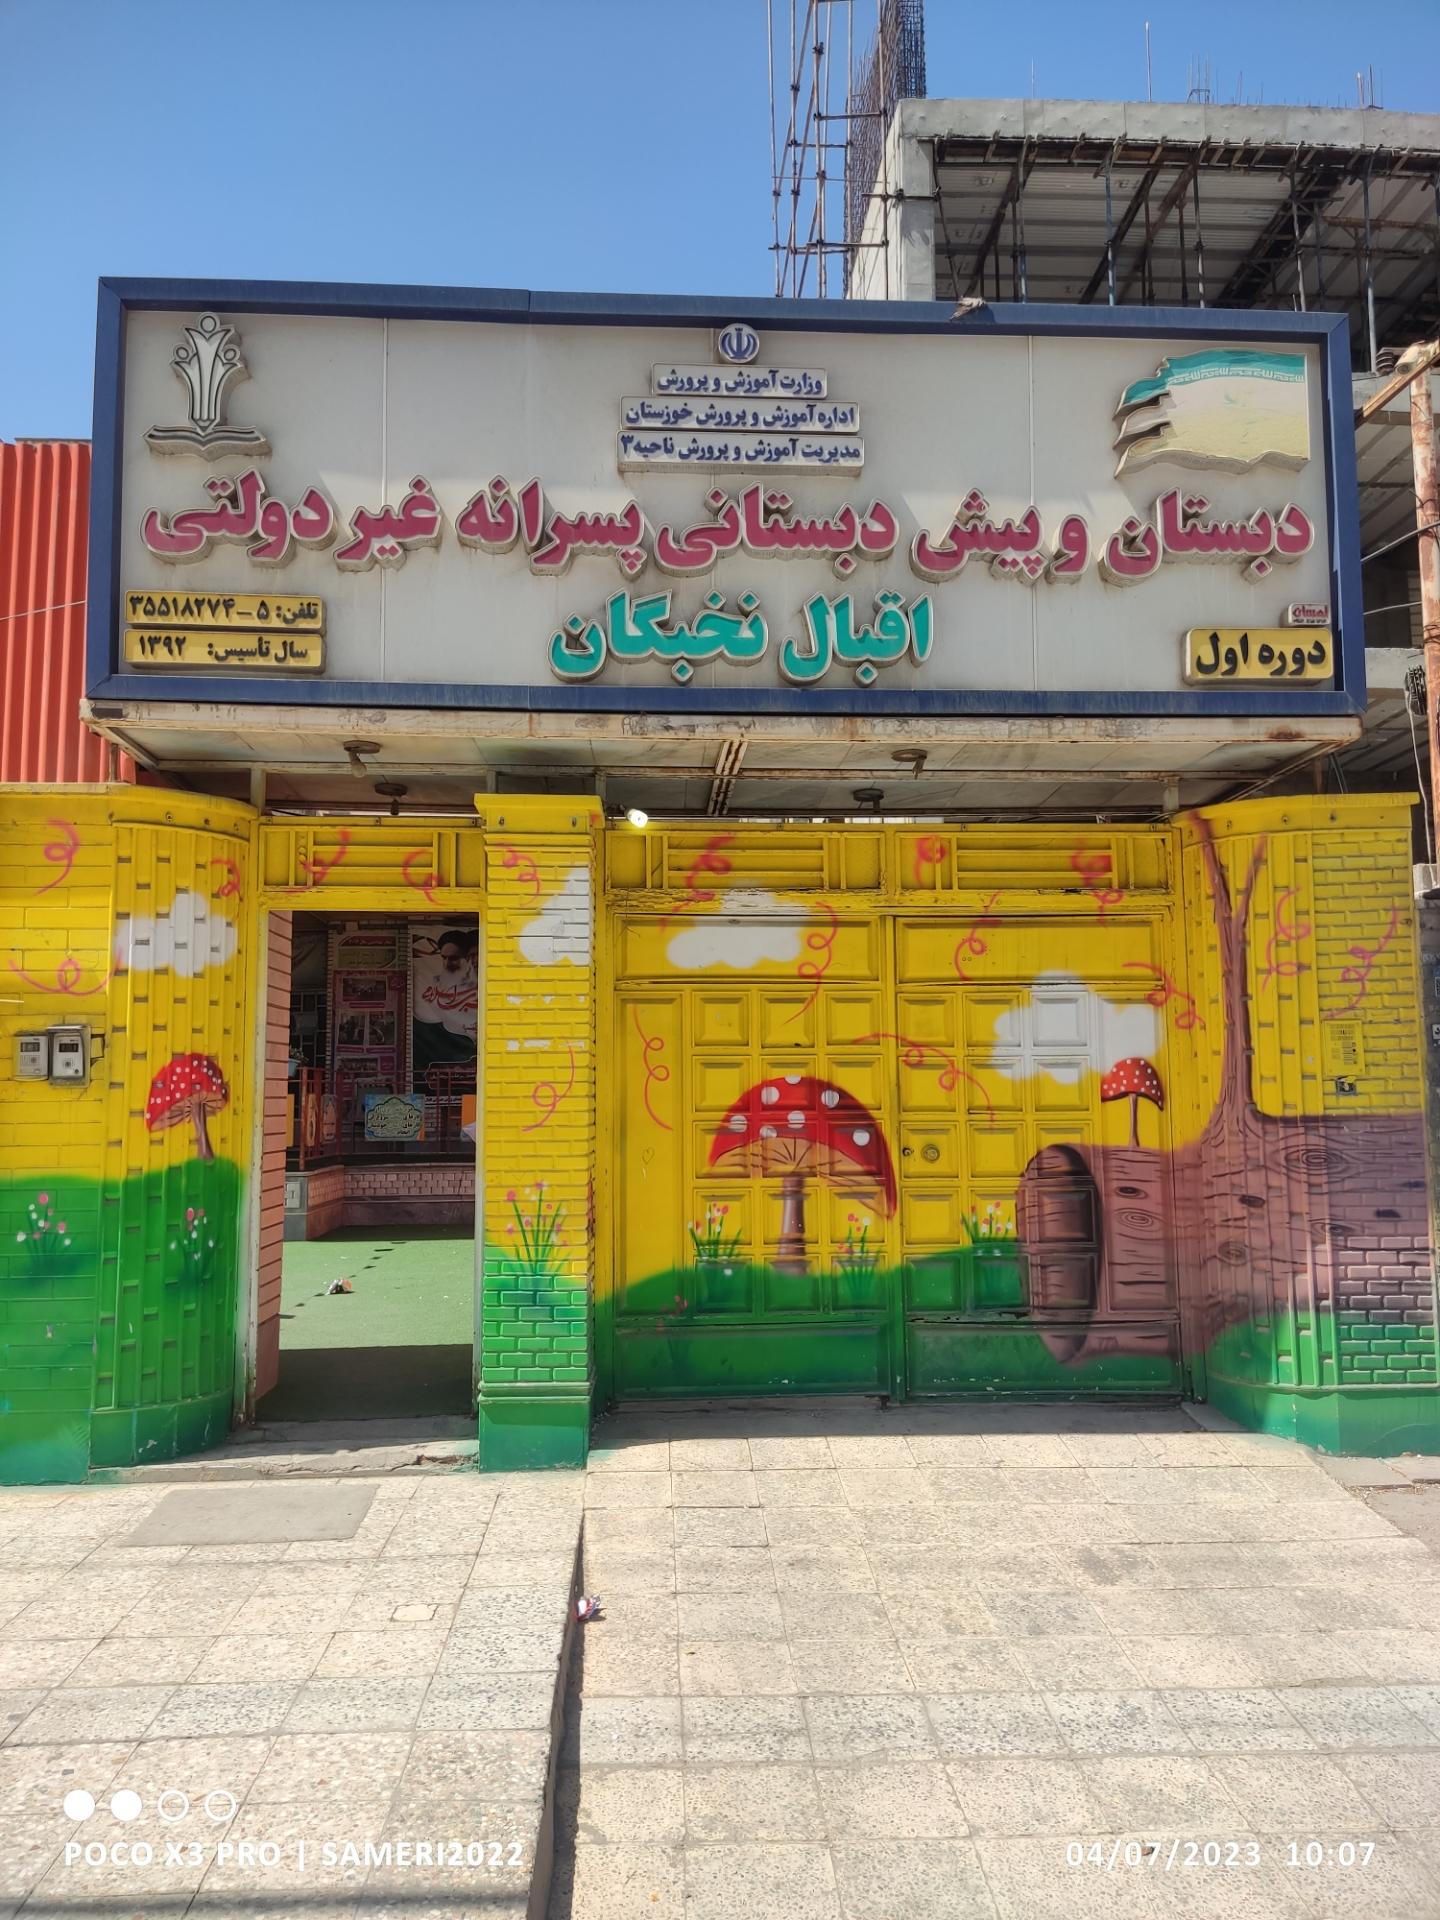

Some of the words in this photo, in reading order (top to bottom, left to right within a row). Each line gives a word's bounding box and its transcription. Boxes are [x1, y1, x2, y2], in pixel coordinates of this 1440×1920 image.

[657, 368, 709, 392] پرورش
[713, 376, 721, 392] و
[724, 369, 779, 393] آموزش
[780, 372, 823, 395] وزارت
[625, 401, 693, 425] خوزستان
[695, 403, 747, 426] پرورش
[750, 412, 759, 426] و
[762, 404, 816, 428] آموزش
[817, 408, 855, 428] اداره
[678, 438, 729, 461] پرورش
[732, 446, 741, 461] و
[745, 438, 799, 462] آموزش
[801, 443, 861, 463] مدیریت
[141, 469, 333, 561] دولتی
[334, 476, 441, 566] غیر
[457, 476, 644, 575] پسرانه
[655, 483, 899, 576] دبستانی
[913, 489, 1042, 579] پیش
[1106, 487, 1314, 580] دبستان
[1051, 514, 1089, 574] و
[139, 635, 186, 656] ۱۳۹۲
[548, 588, 768, 684] نخبگان
[780, 591, 934, 684] اقبال
[274, 640, 308, 663] سال
[1196, 632, 1249, 676] اول
[1258, 640, 1326, 676] دوره
